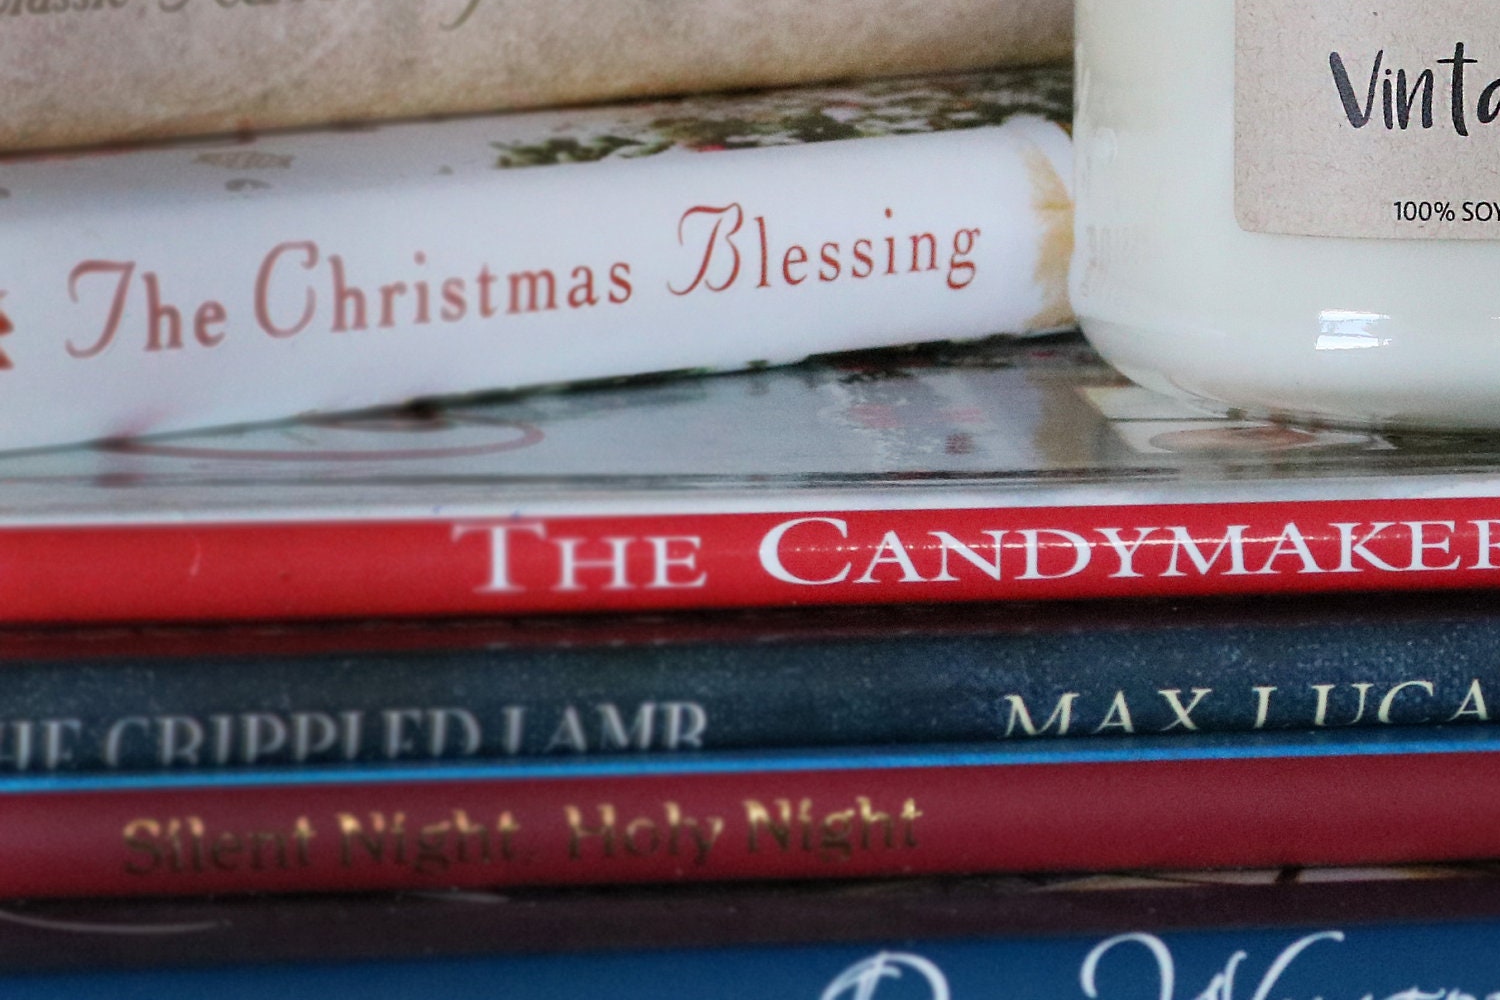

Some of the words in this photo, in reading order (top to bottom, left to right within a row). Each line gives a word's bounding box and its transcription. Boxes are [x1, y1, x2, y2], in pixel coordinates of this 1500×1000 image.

[1393, 200, 1456, 222] 100%
[65, 259, 228, 359] The
[253, 240, 634, 340] Christmas
[666, 201, 982, 298] Blessing
[451, 521, 708, 594] THE
[1003, 686, 1212, 738] MAX
[121, 814, 316, 874] Silent
[565, 800, 726, 864] Holy
[743, 797, 923, 861] Night
